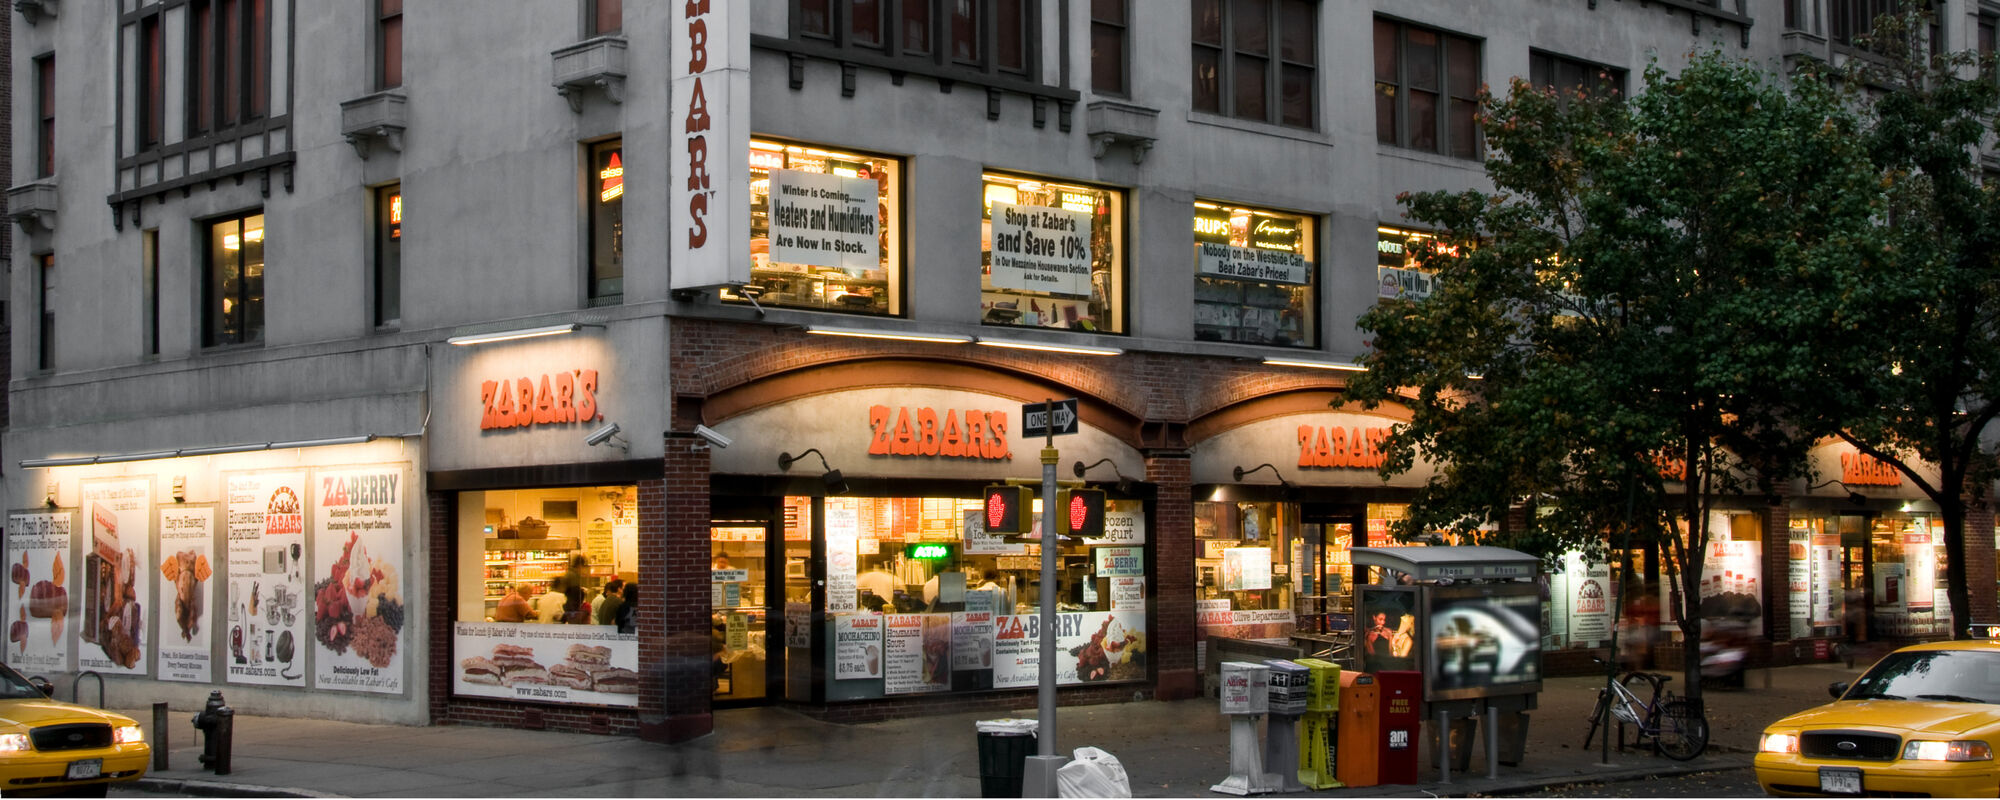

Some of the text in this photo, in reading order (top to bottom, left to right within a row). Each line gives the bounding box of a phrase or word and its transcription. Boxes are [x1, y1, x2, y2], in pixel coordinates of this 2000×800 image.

[782, 184, 809, 197] Winter
[811, 187, 818, 198] is
[1062, 192, 1093, 205] KUHN
[774, 199, 807, 229] Heaters
[810, 204, 825, 230] and
[1005, 207, 1075, 232] Shop at Zabar's
[1194, 217, 1229, 236] RUPS
[776, 234, 866, 254] Are Now In Stock.
[997, 231, 1086, 260] and Save 10%
[1203, 244, 1303, 267] Nobody on the Westside Can
[1002, 257, 1010, 267] Our
[1011, 258, 1037, 270] Mezzanine
[1038, 261, 1068, 273] Housewares
[1069, 264, 1089, 274] Section.
[1219, 261, 1289, 280] Beat Zabar's Prices!
[1024, 272, 1032, 280] Ask
[1041, 274, 1058, 282] Details.
[1397, 270, 1413, 291] Visit
[1415, 273, 1429, 293] Our
[480, 368, 598, 429] ZABAR'S
[1030, 410, 1070, 427] ONE WAY
[868, 405, 1009, 460] ZABAR'S
[265, 514, 303, 535] ZABARS
[1105, 517, 1133, 527] rozen
[1104, 528, 1134, 542] ogurt
[913, 545, 948, 558] ATM
[888, 616, 921, 628] ZABARS
[1233, 611, 1251, 621] Olive
[1252, 611, 1290, 623] Department
[838, 632, 880, 641] MOCHACHINO
[887, 638, 905, 648] SOUPS
[333, 666, 379, 676] Deliciously Low Fat
[854, 662, 866, 673] each
[516, 687, 567, 698] www.zabars.com
